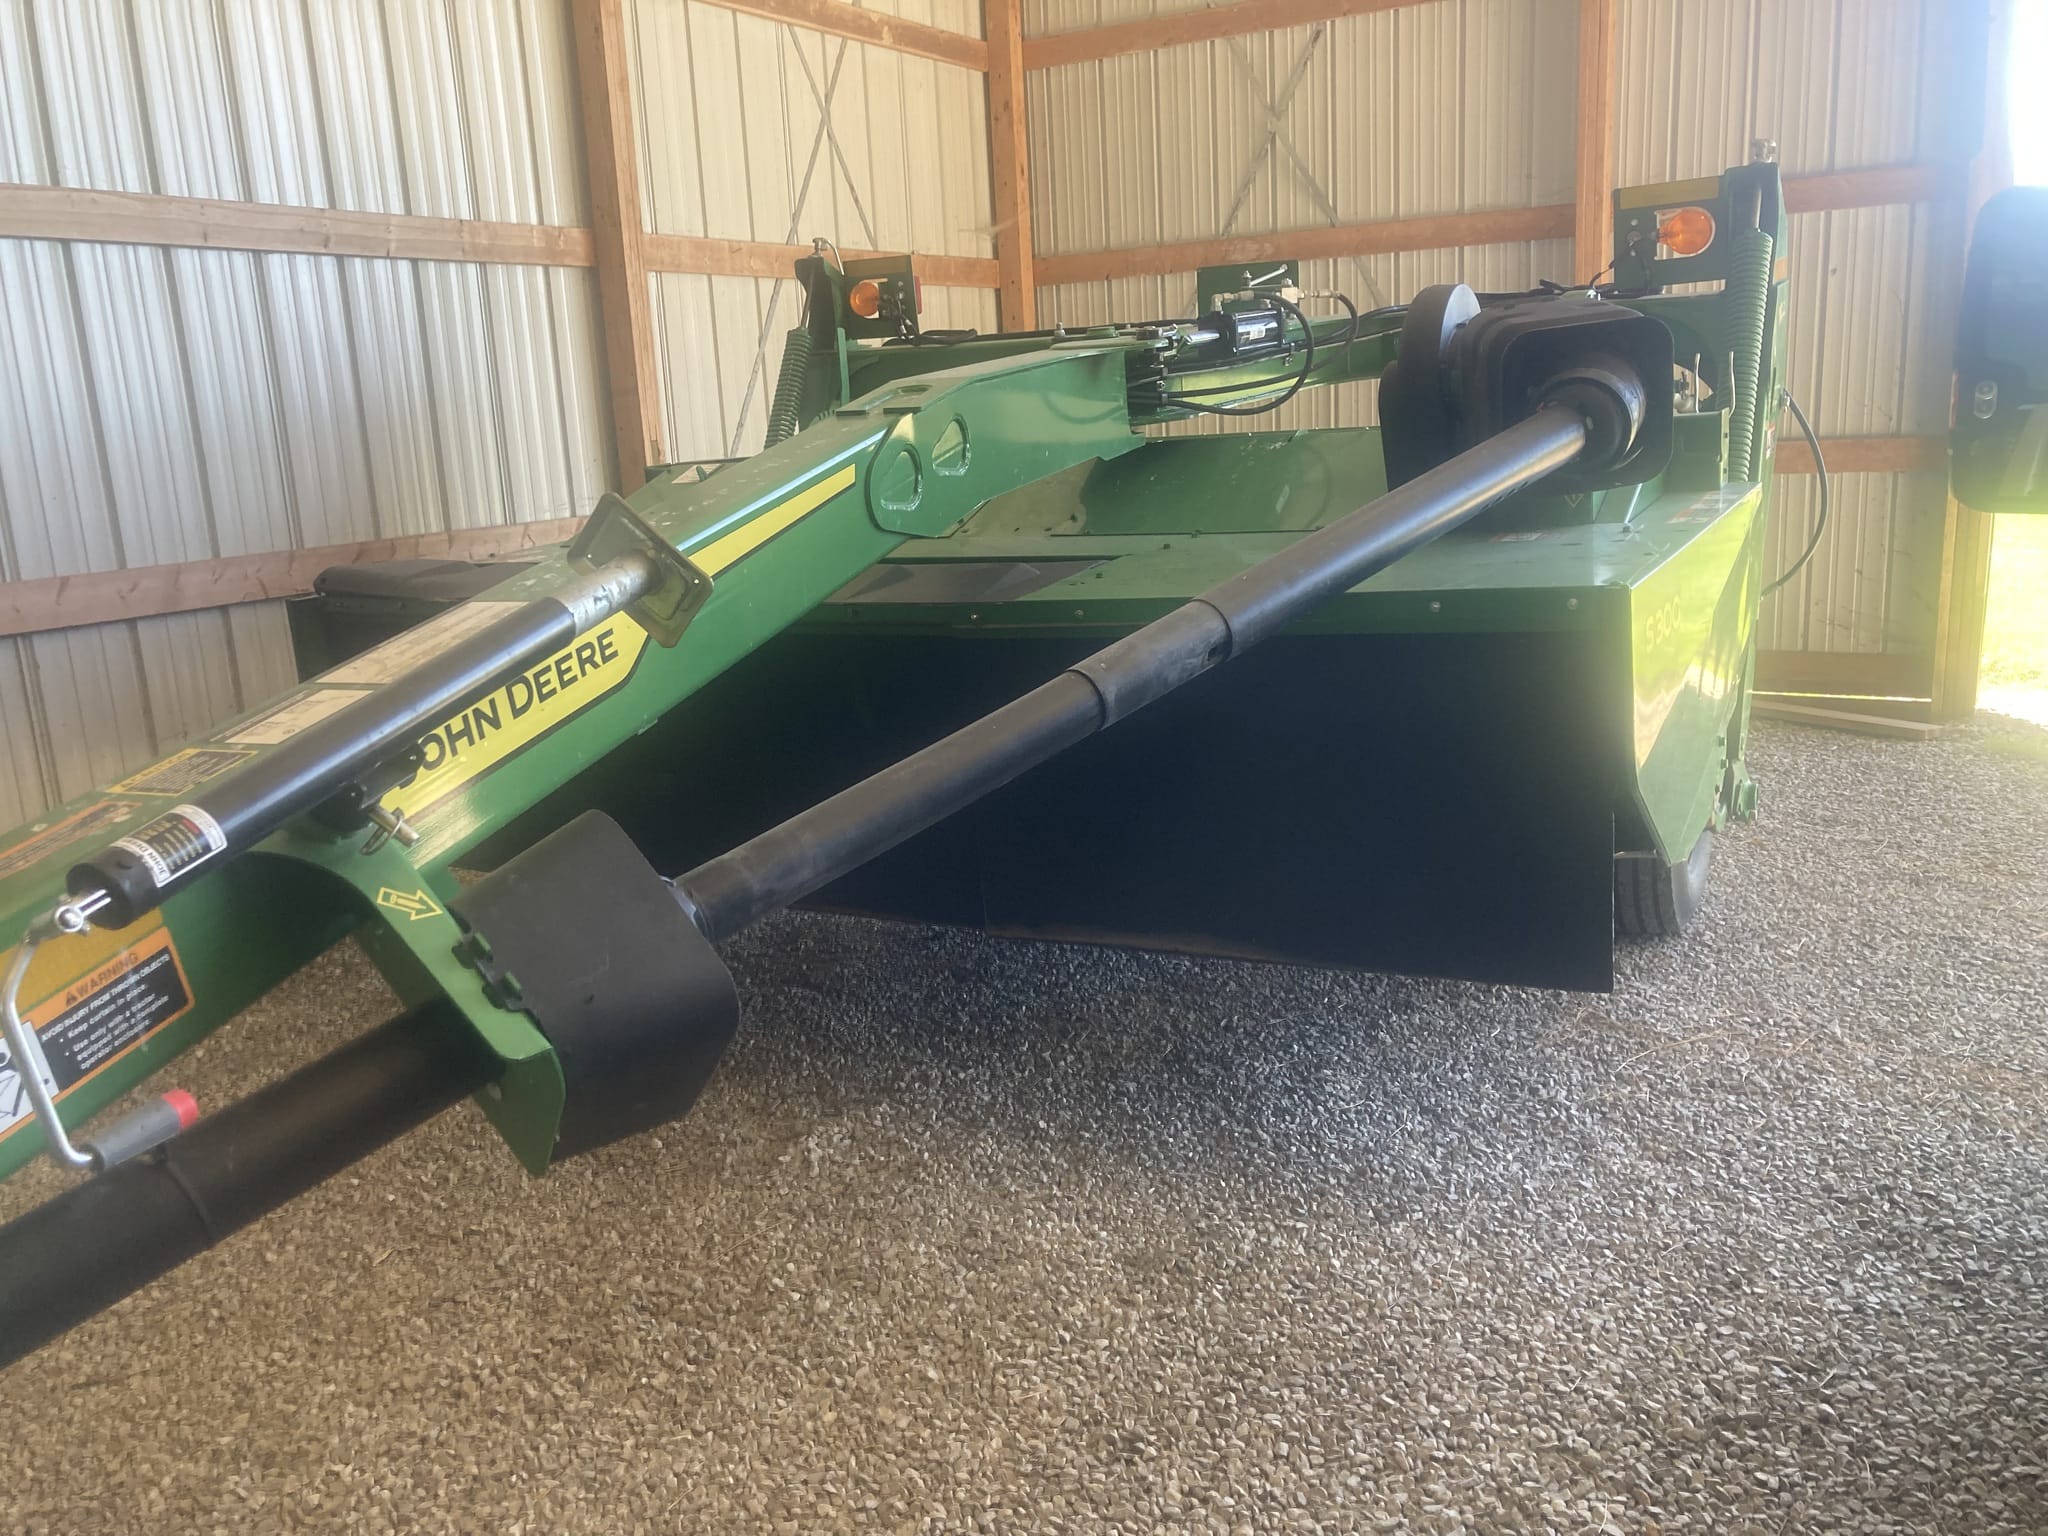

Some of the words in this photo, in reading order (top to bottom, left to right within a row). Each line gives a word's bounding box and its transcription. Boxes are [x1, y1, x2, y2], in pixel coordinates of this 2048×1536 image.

[1646, 594, 1681, 654] S300
[400, 697, 502, 789] OHN
[505, 628, 619, 720] DEERE
[41, 1023, 64, 1042] AVOID
[90, 992, 111, 1010] FROM
[140, 954, 170, 977] OBJECTS
[76, 952, 139, 998] WARNING
[68, 1022, 88, 1039] Keep
[89, 1003, 116, 1025] curtain
[73, 1039, 89, 1052] Use
